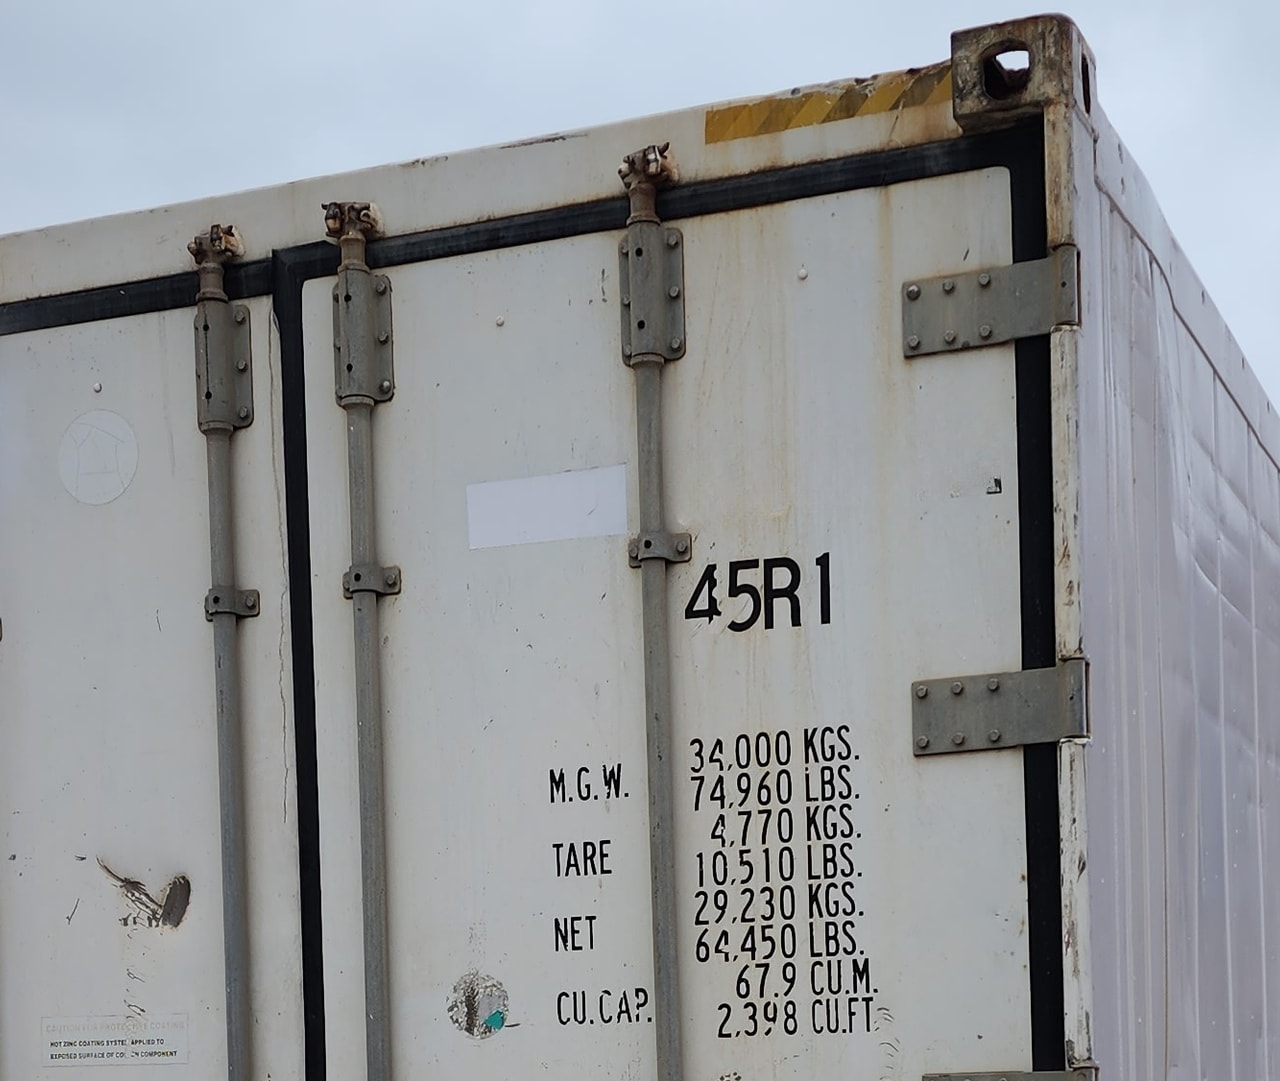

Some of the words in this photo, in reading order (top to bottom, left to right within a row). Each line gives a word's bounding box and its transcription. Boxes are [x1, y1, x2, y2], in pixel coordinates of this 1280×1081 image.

[685, 552, 831, 632] 45R1
[690, 731, 791, 773] 34,000
[803, 725, 860, 763] KGS.
[549, 764, 630, 803] M.G.W.
[690, 769, 792, 811] 74,960
[804, 766, 860, 802] LBS.
[711, 808, 793, 847] 4,770
[806, 804, 862, 842] KGS.
[552, 840, 613, 877] TARE
[695, 847, 795, 886] 10,510
[807, 843, 863, 880] LBS.
[694, 886, 795, 926] 29,230
[808, 882, 864, 919] KGS.
[554, 916, 596, 952] NET
[695, 925, 797, 963] 64,450
[809, 921, 864, 957] LBS.
[736, 963, 797, 1000] 67.9
[810, 958, 878, 996] CU.M.
[717, 1001, 798, 1038] 2,398
[131, 1038, 155, 1046] APPLIED
[140, 1050, 177, 1058] COMPONENT
